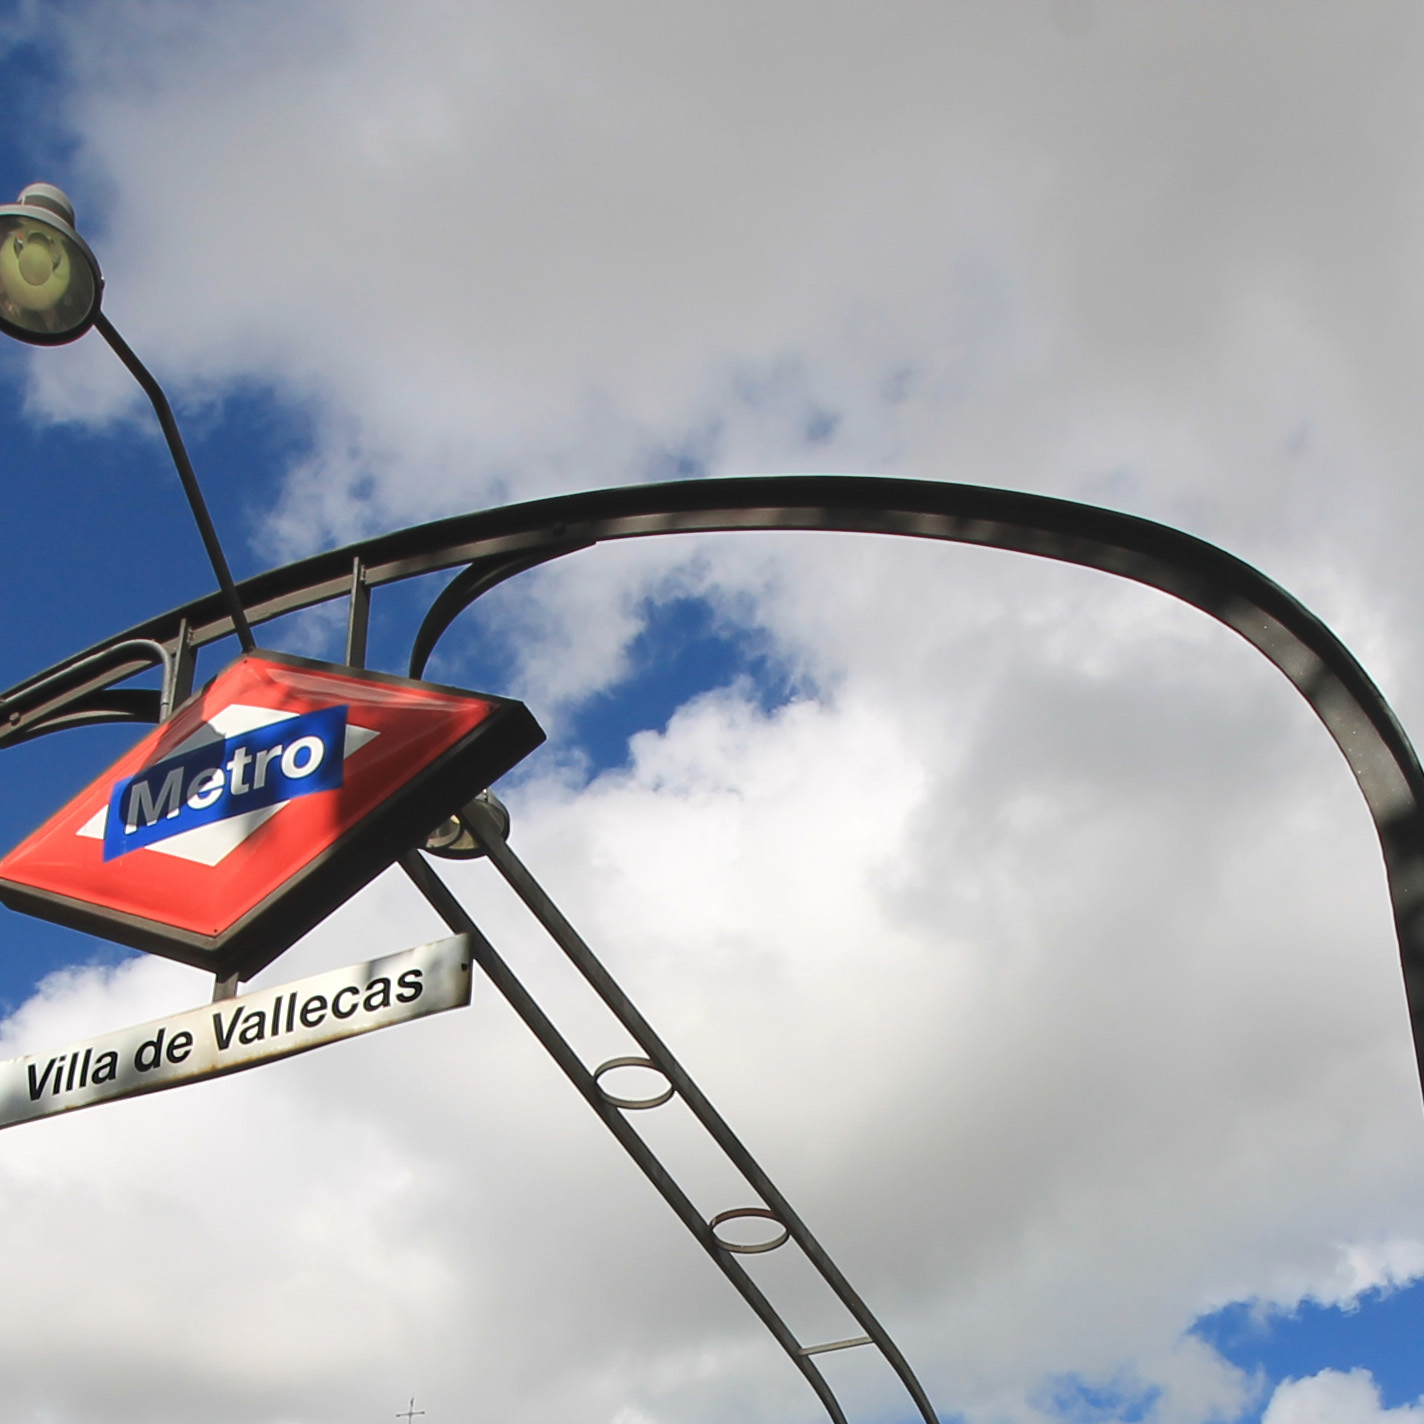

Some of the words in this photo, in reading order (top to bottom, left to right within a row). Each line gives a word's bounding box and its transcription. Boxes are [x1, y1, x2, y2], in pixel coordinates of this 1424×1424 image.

[124, 735, 325, 835] Metro
[26, 1048, 118, 1102] Villa
[133, 1027, 193, 1073] de
[212, 968, 424, 1053] Vallecas
